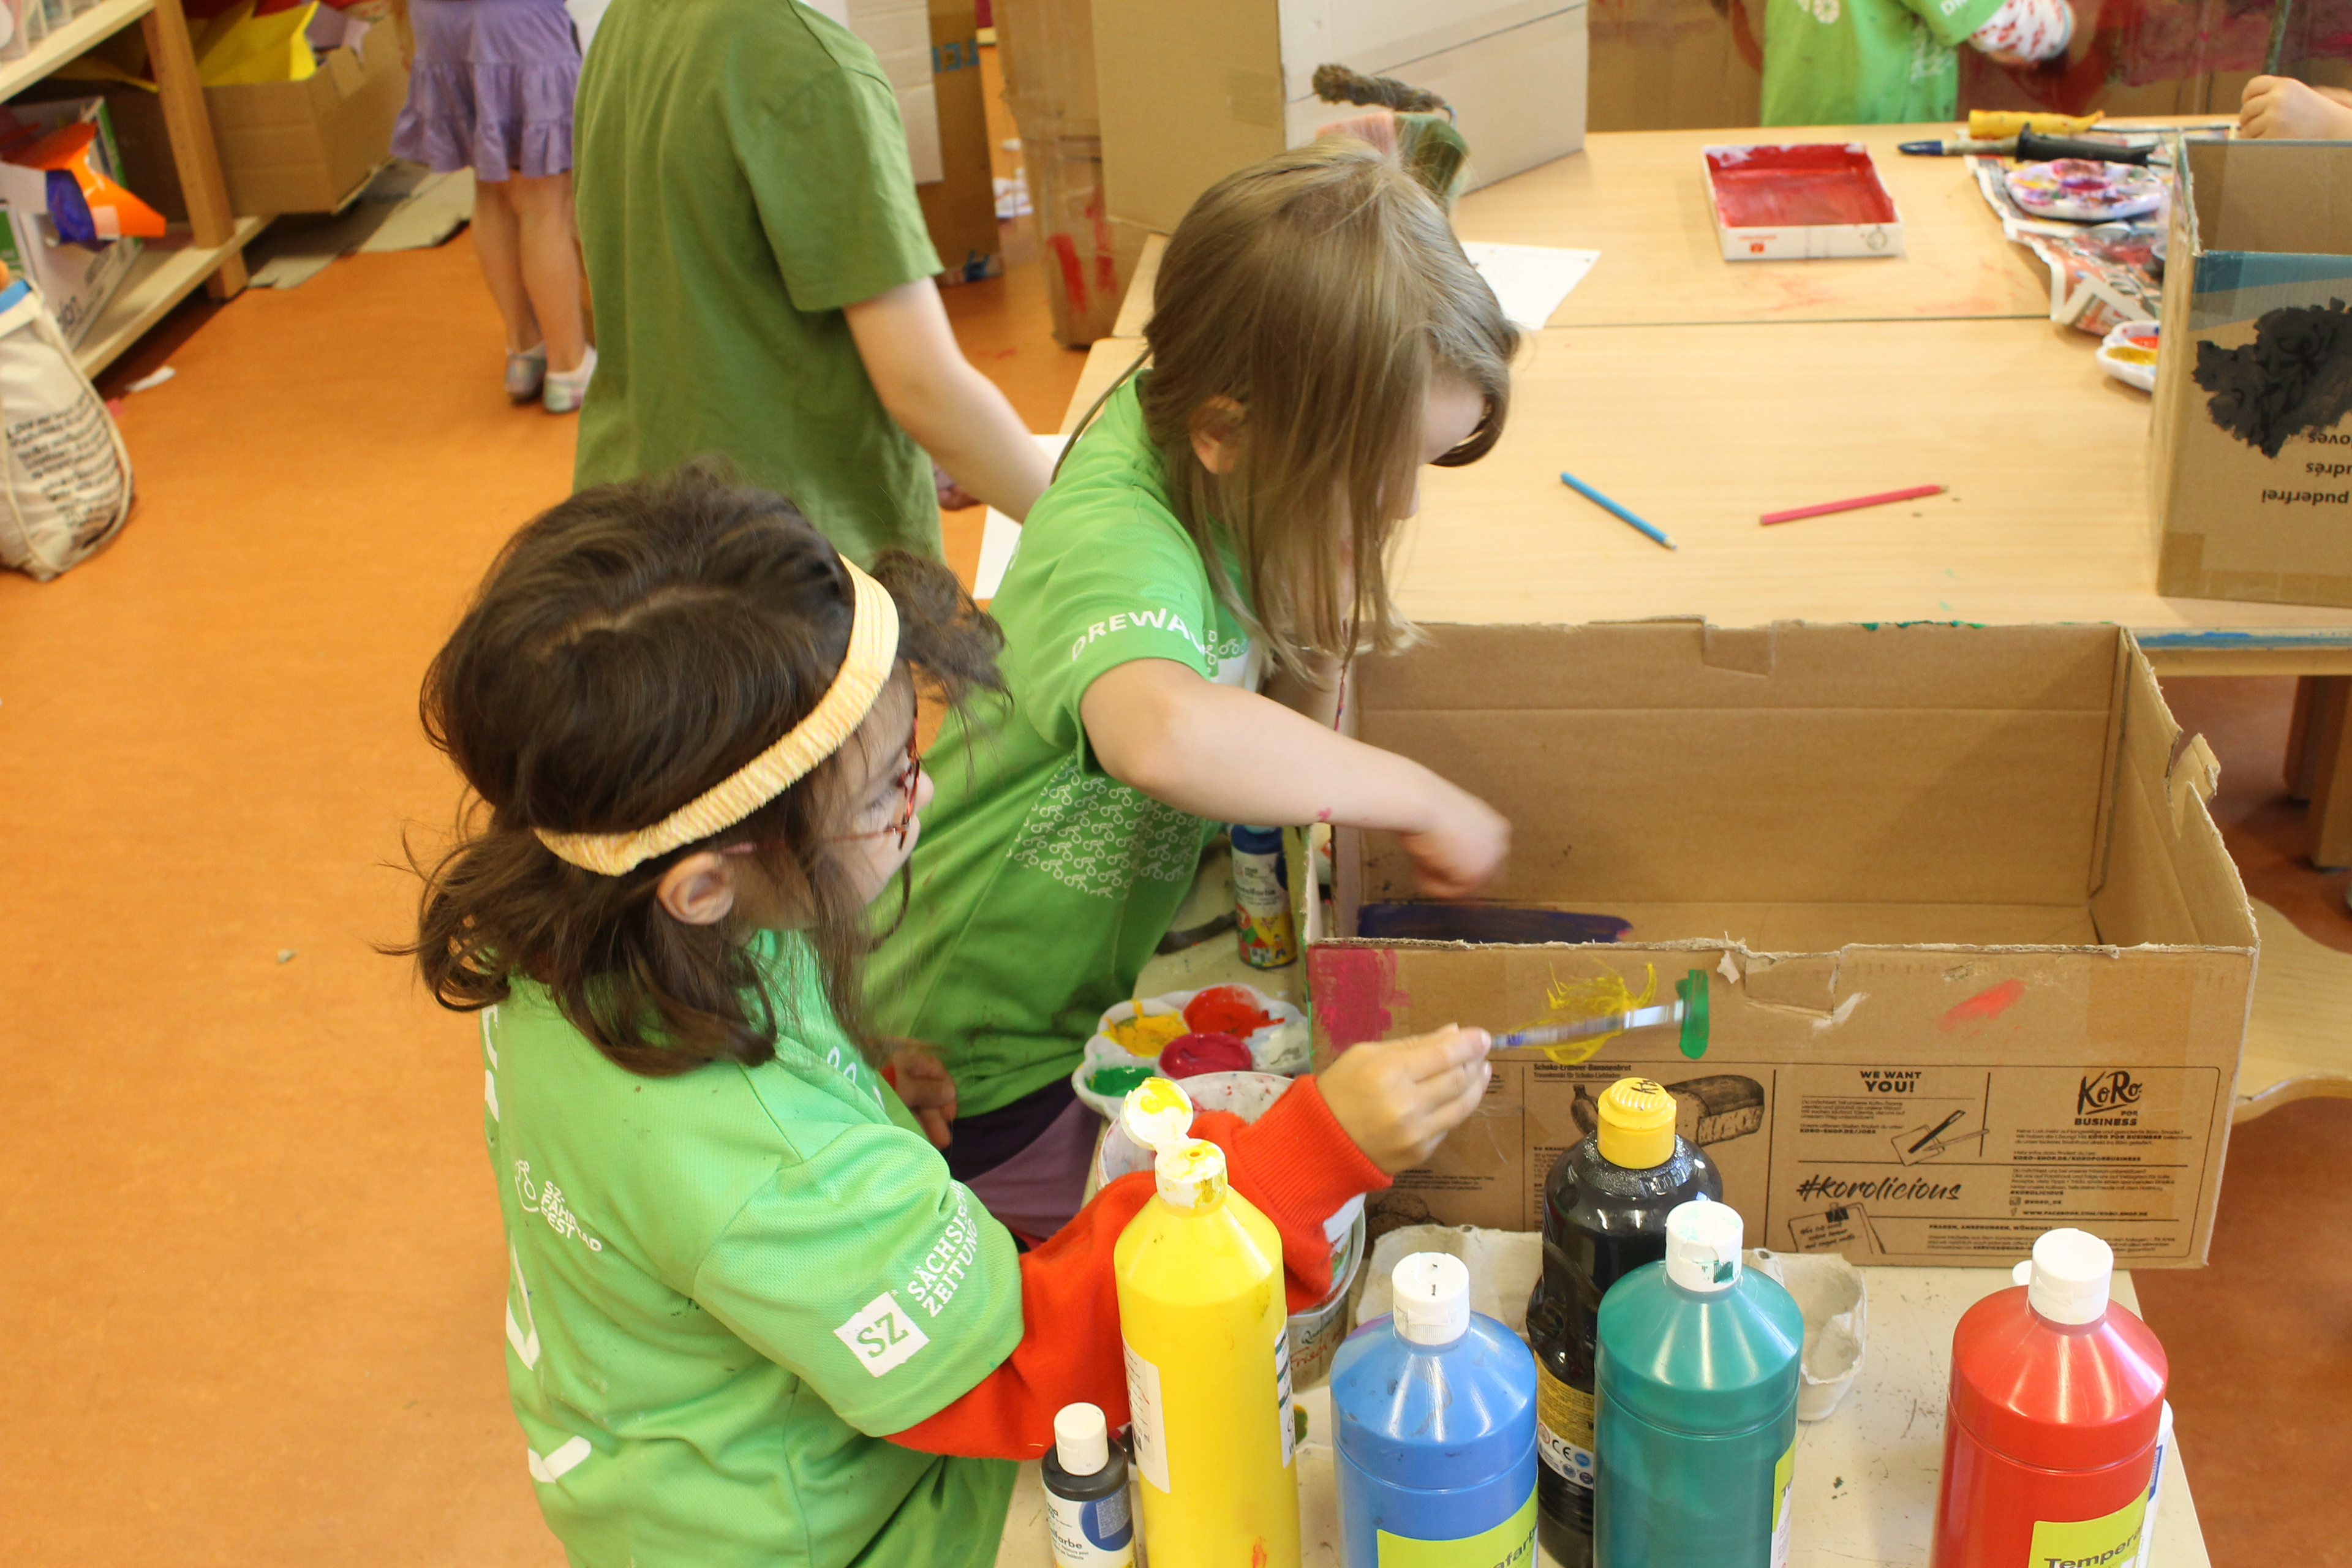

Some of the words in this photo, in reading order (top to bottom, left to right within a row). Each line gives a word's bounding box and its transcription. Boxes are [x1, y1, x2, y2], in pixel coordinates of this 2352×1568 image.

[2307, 431, 2352, 445] oves
[2261, 489, 2350, 506] puderfrei
[1865, 1080, 1915, 1093] YOU!
[2076, 1071, 2143, 1115] KoRo
[2075, 1117, 2138, 1126] BUSINESS
[1796, 1174, 1962, 1202] #korolicious
[541, 1193, 603, 1252] FAHRAD
[921, 1217, 978, 1317] ZEITUNG
[856, 1312, 910, 1358] SZ
